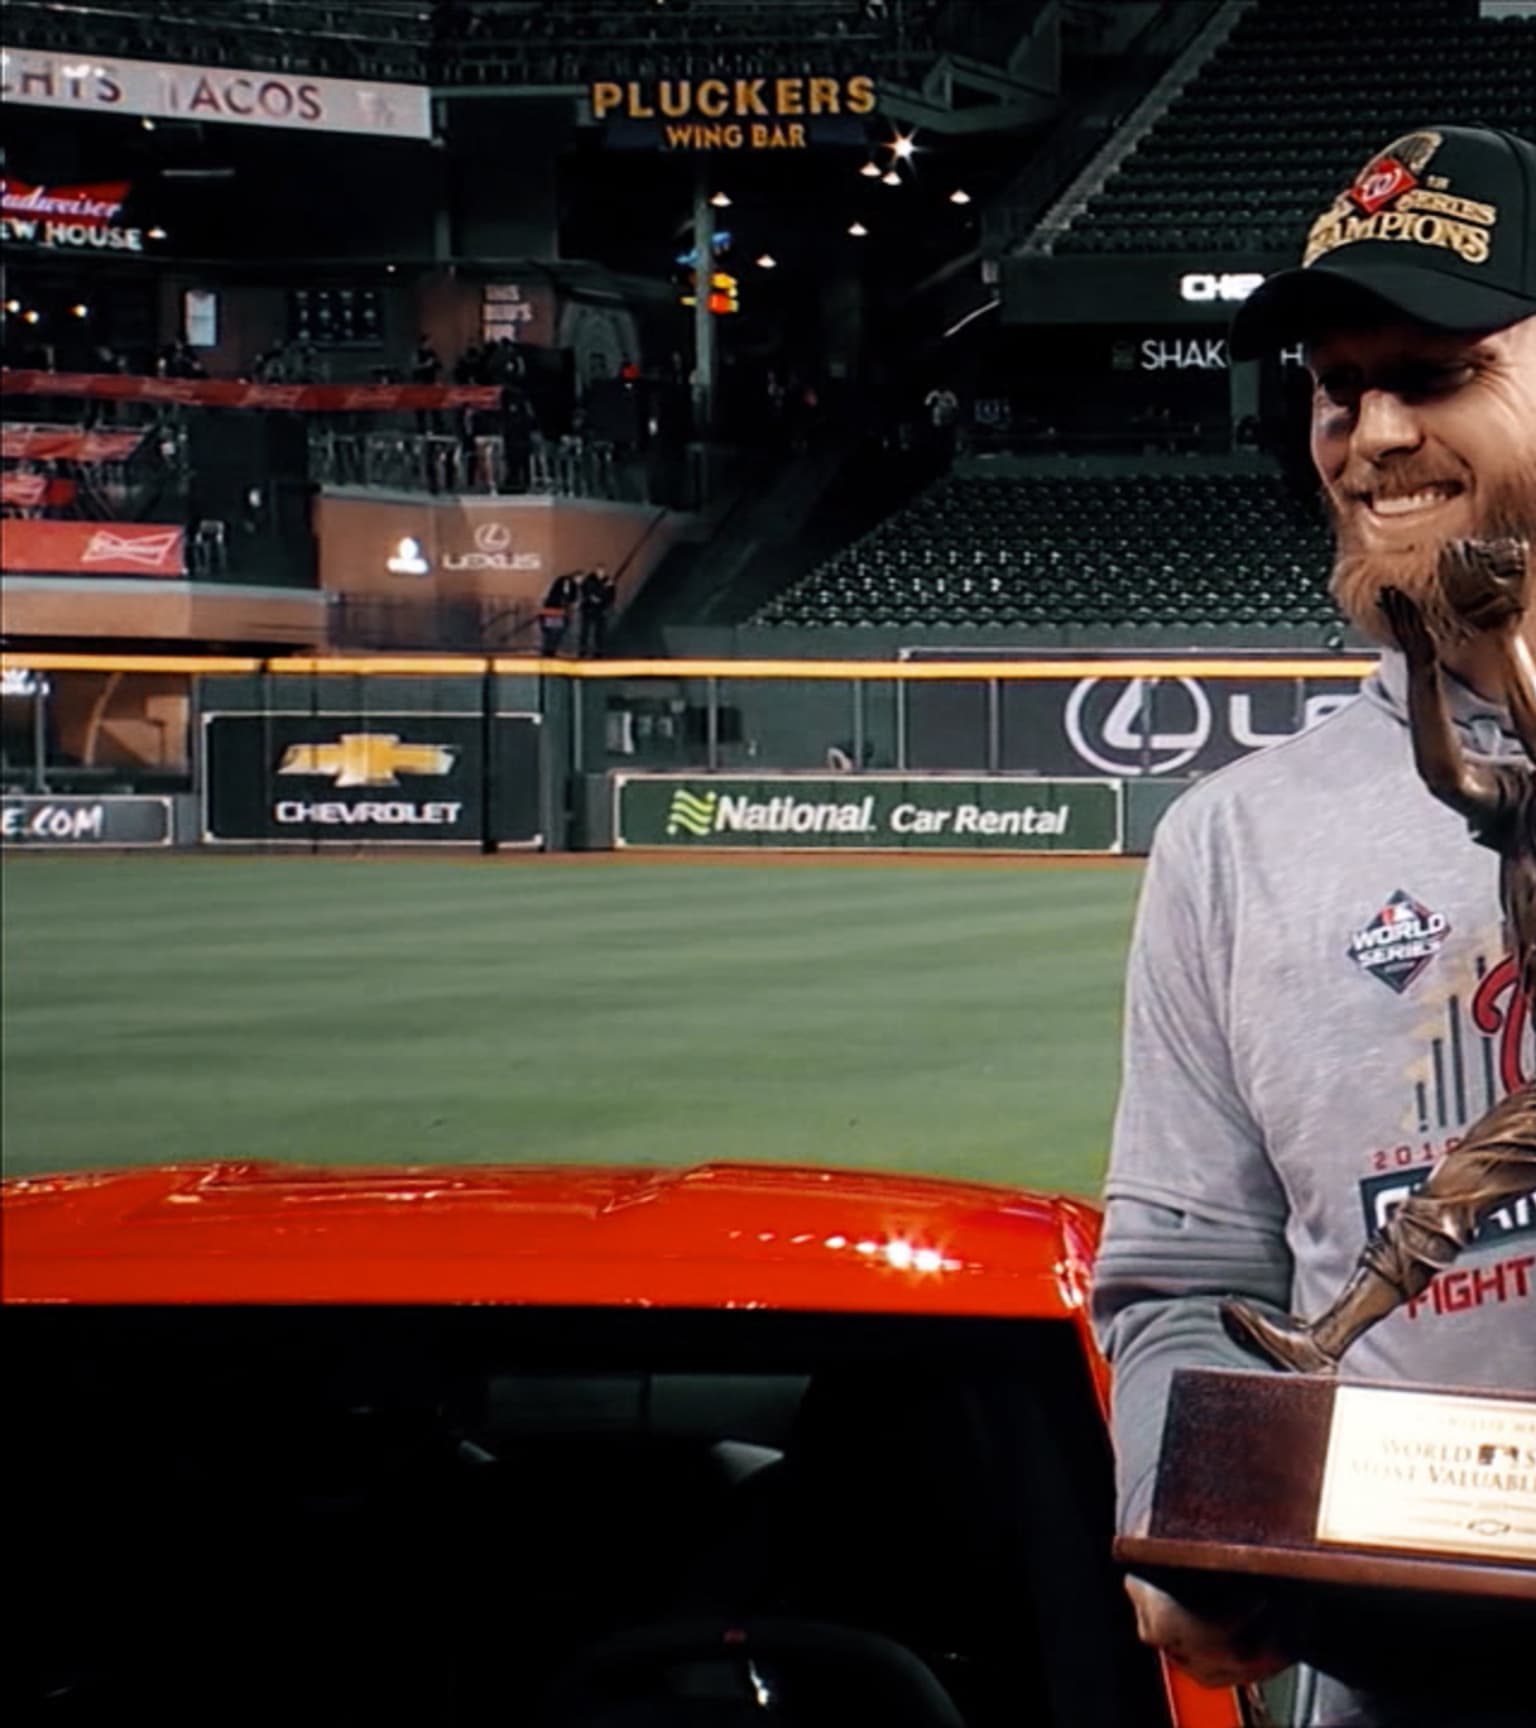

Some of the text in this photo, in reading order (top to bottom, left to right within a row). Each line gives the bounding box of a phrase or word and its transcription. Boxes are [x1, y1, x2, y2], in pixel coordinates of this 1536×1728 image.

[163, 75, 322, 120] TACOS
[592, 75, 877, 118] PLUCKERS
[667, 123, 807, 148] WING BAR
[0, 180, 121, 217] udweiser
[45, 221, 143, 250] HOUSE
[1141, 340, 1227, 369] SHAK
[442, 553, 541, 570] LEXUS
[275, 802, 463, 823] CHEVROLET
[890, 805, 947, 832] Car
[955, 806, 1068, 834] Rental
[1351, 913, 1446, 950] WORLD
[1358, 941, 1441, 967] SERIES
[1381, 1434, 1471, 1461] WORLD
